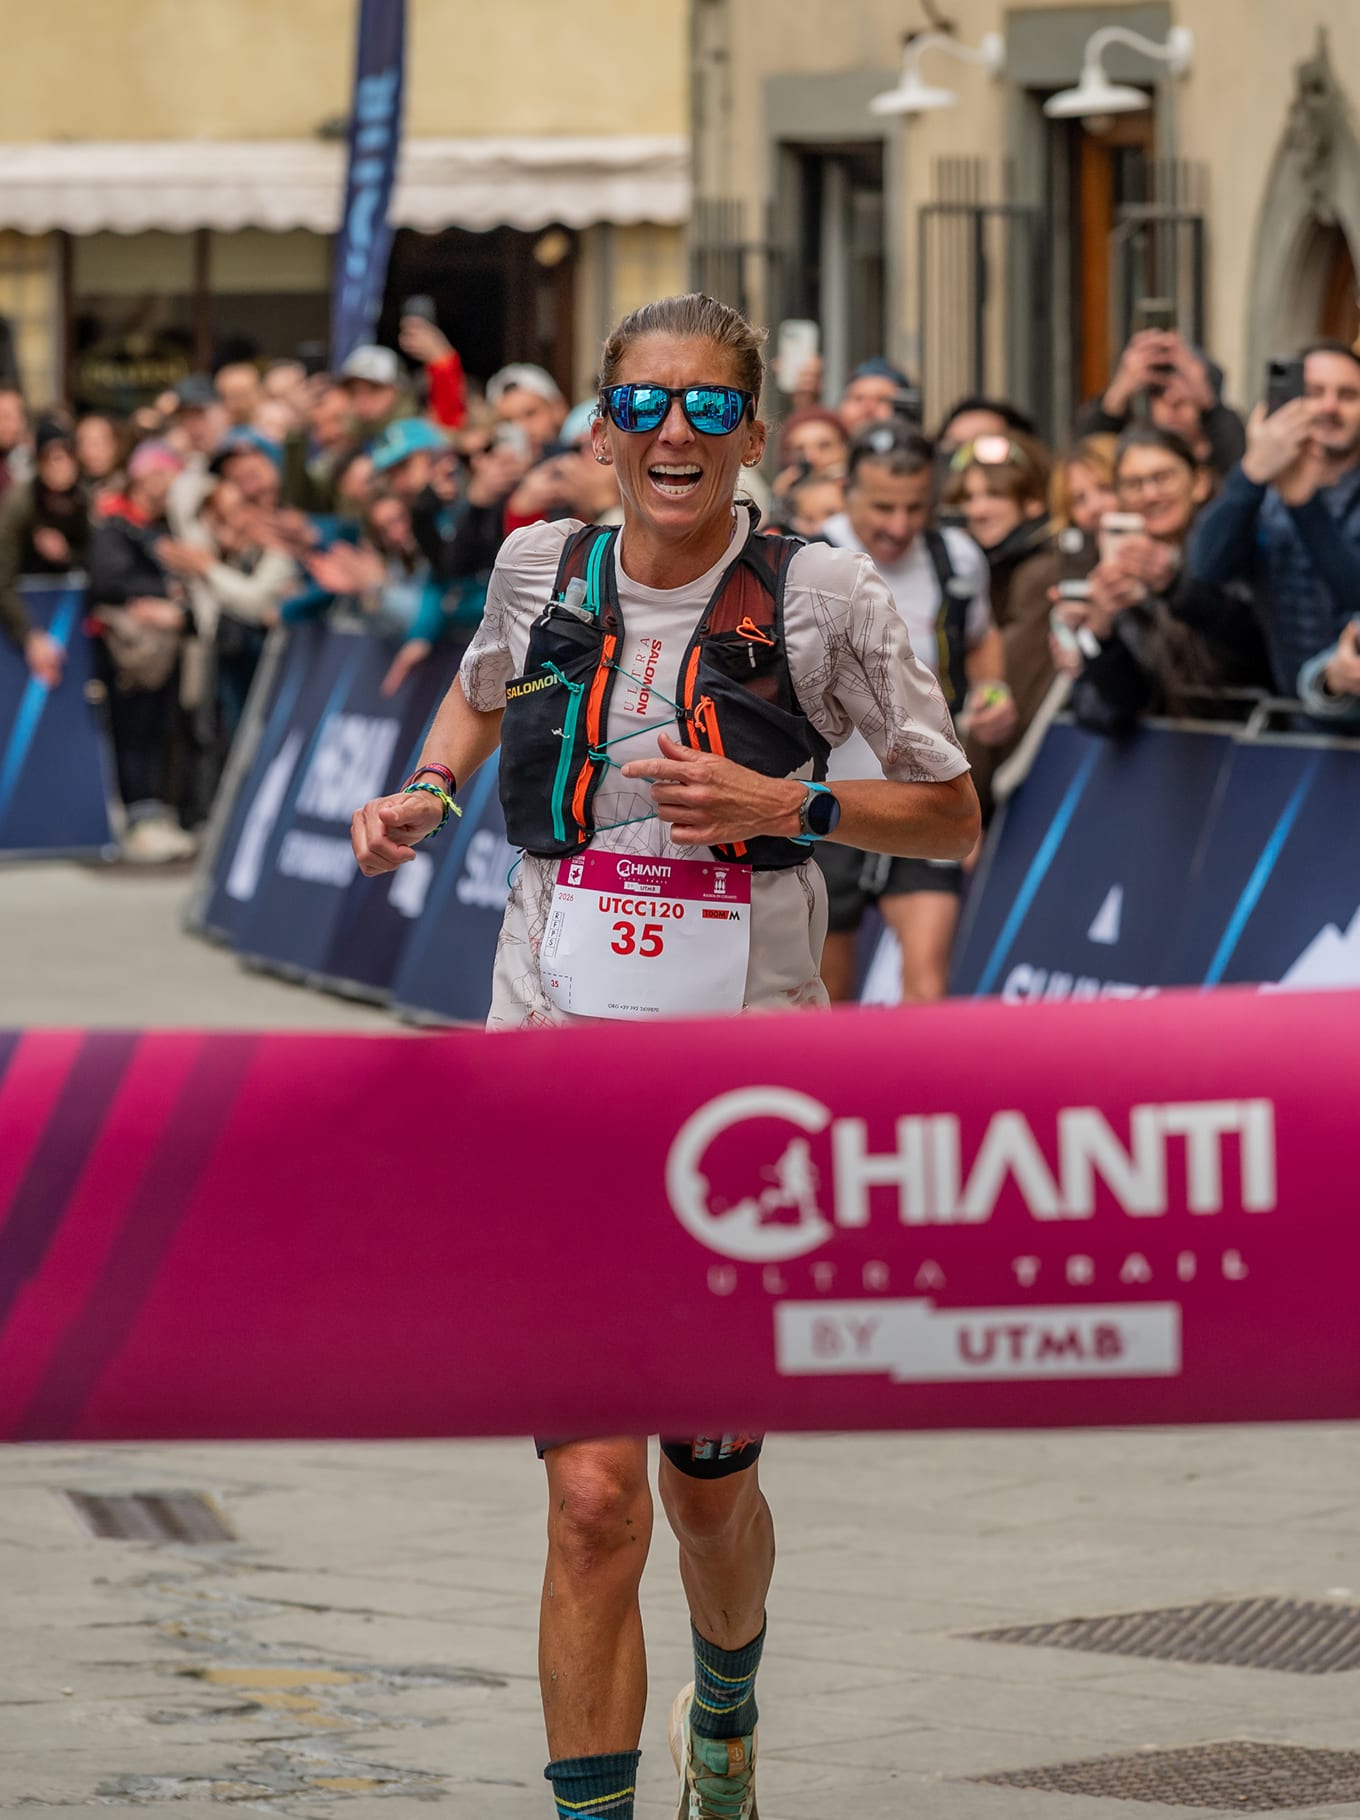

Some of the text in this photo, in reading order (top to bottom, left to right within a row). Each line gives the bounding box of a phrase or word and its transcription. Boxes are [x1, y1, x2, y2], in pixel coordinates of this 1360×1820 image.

[506, 671, 565, 700] SALOMON
[636, 639, 662, 715] SALOMON
[616, 859, 671, 878] CHIANTI
[558, 892, 574, 902] 2026
[598, 896, 685, 920] UTCC120
[610, 920, 664, 958] 35
[550, 979, 559, 988] 35
[667, 1085, 1277, 1262] CHIANTI
[706, 1247, 1249, 1296] ULTRA TRAIL
[811, 1315, 1126, 1365] BY UTMB
